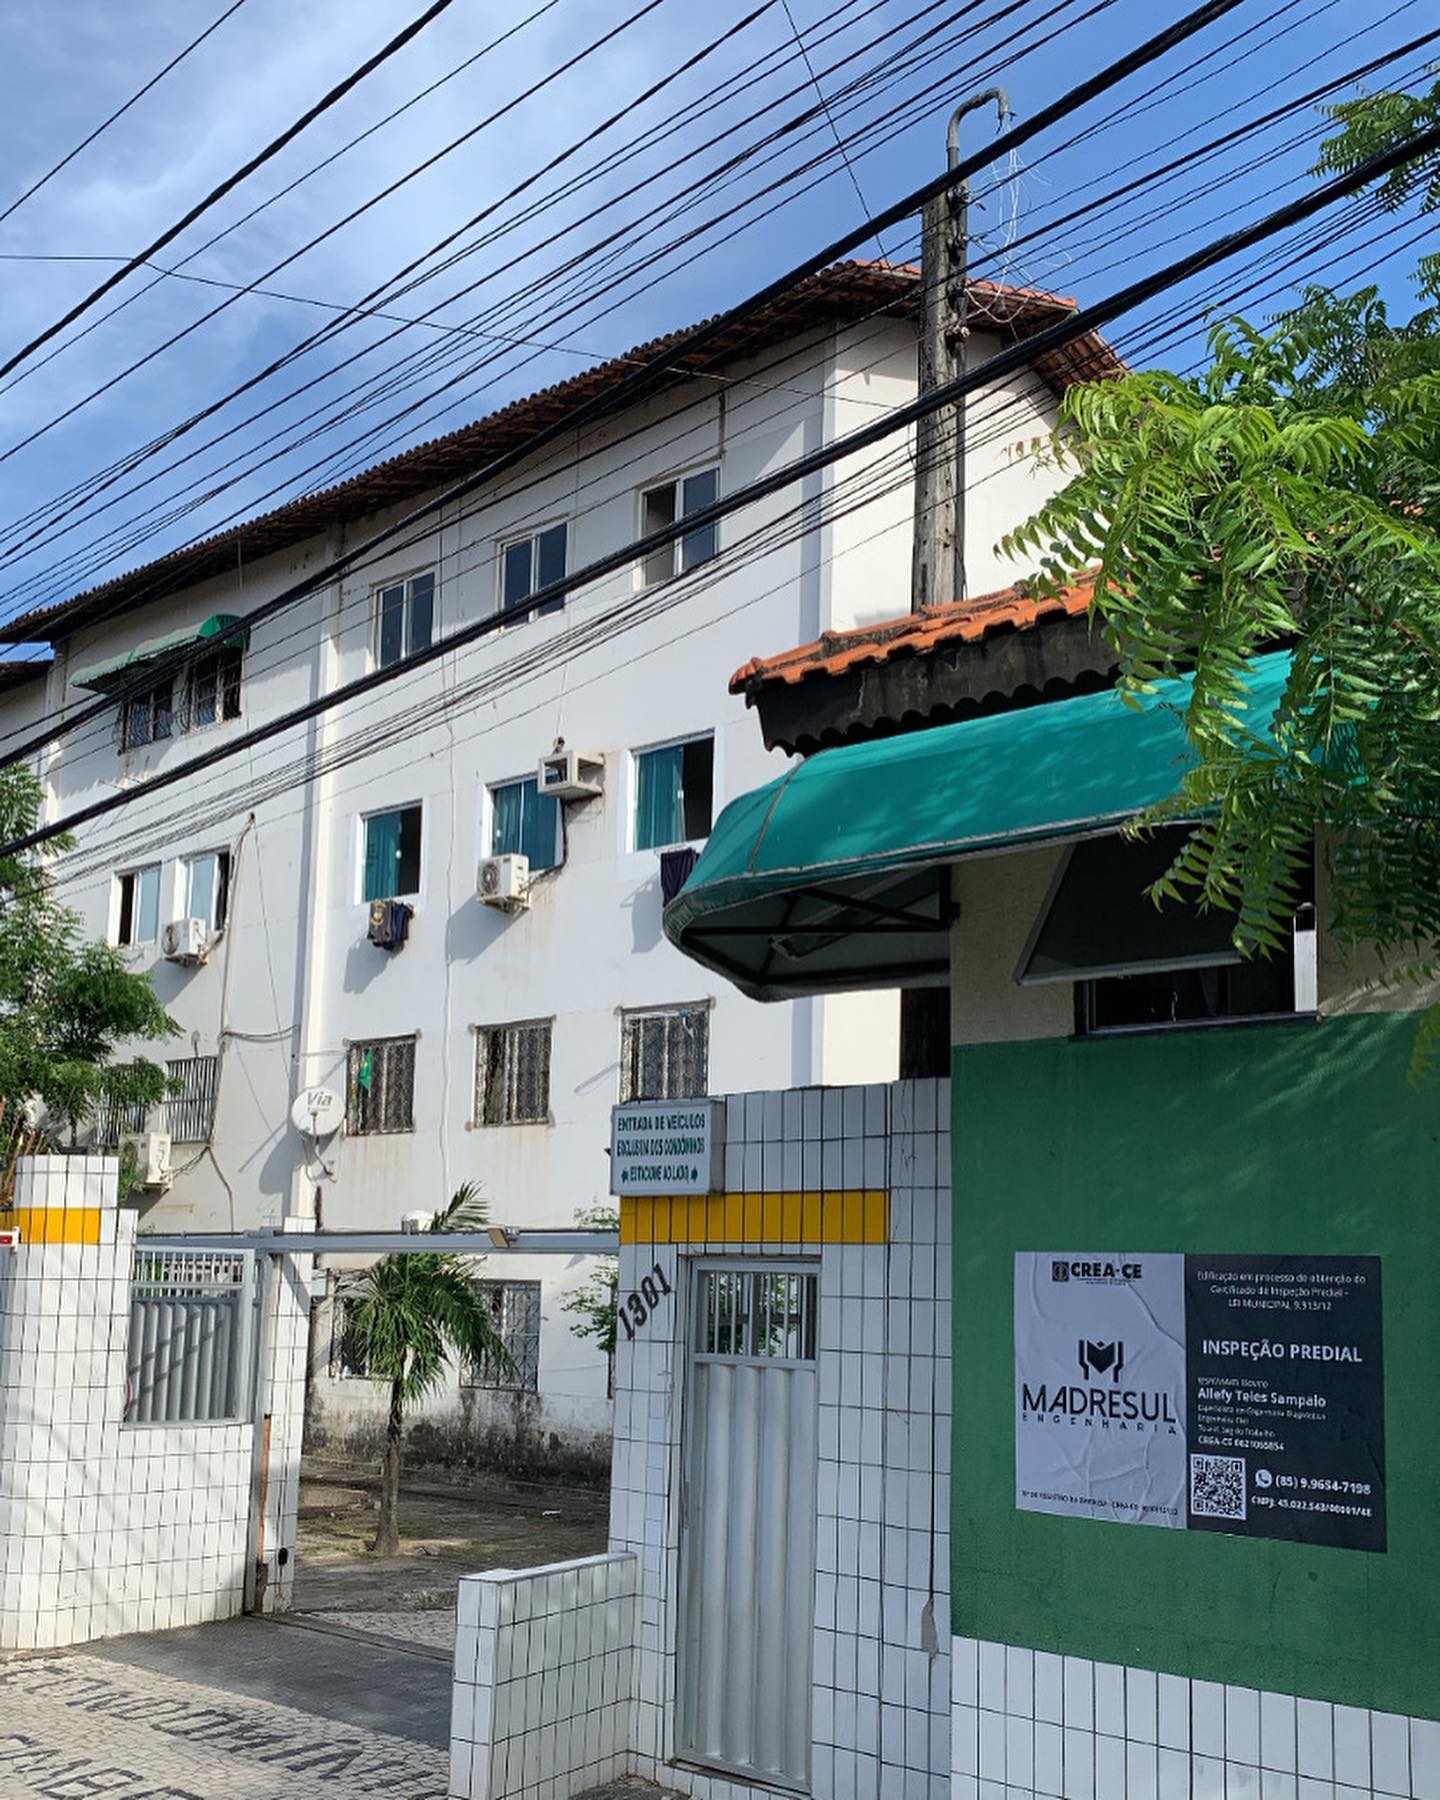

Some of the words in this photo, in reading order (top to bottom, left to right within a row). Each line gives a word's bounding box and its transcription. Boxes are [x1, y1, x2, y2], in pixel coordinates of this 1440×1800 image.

[308, 1091, 332, 1105] Via
[617, 1116, 652, 1131] ENTRADA
[655, 1115, 665, 1130] DE
[666, 1111, 706, 1130] VEÍCULOS
[665, 1134, 706, 1155] CONDÔMINOS
[1071, 1261, 1142, 1279] CREA-CE
[1197, 1270, 1239, 1284] Edificação
[1240, 1273, 1254, 1281] em
[1255, 1273, 1295, 1284] processo
[1296, 1273, 1308, 1283] de
[1309, 1273, 1353, 1286] obtenção
[1210, 1284, 1256, 1296] Certificado
[1270, 1285, 1310, 1298] Inspeção
[1312, 1287, 1343, 1298] Predial
[619, 1263, 672, 1341] 1301
[1242, 1299, 1291, 1311] MUNICIPAL
[1202, 1339, 1285, 1361] INSPEÇÃO
[1290, 1343, 1363, 1362] PREDIAL
[1022, 1383, 1177, 1423] MADRESUL
[1197, 1387, 1232, 1405] Allefy
[1235, 1390, 1268, 1403] Teles
[1270, 1392, 1328, 1409] Sampaio
[1022, 1412, 1177, 1434] ENGENHARIA
[1275, 1475, 1299, 1490] (85)
[1300, 1477, 1372, 1496] 9.9654-7198
